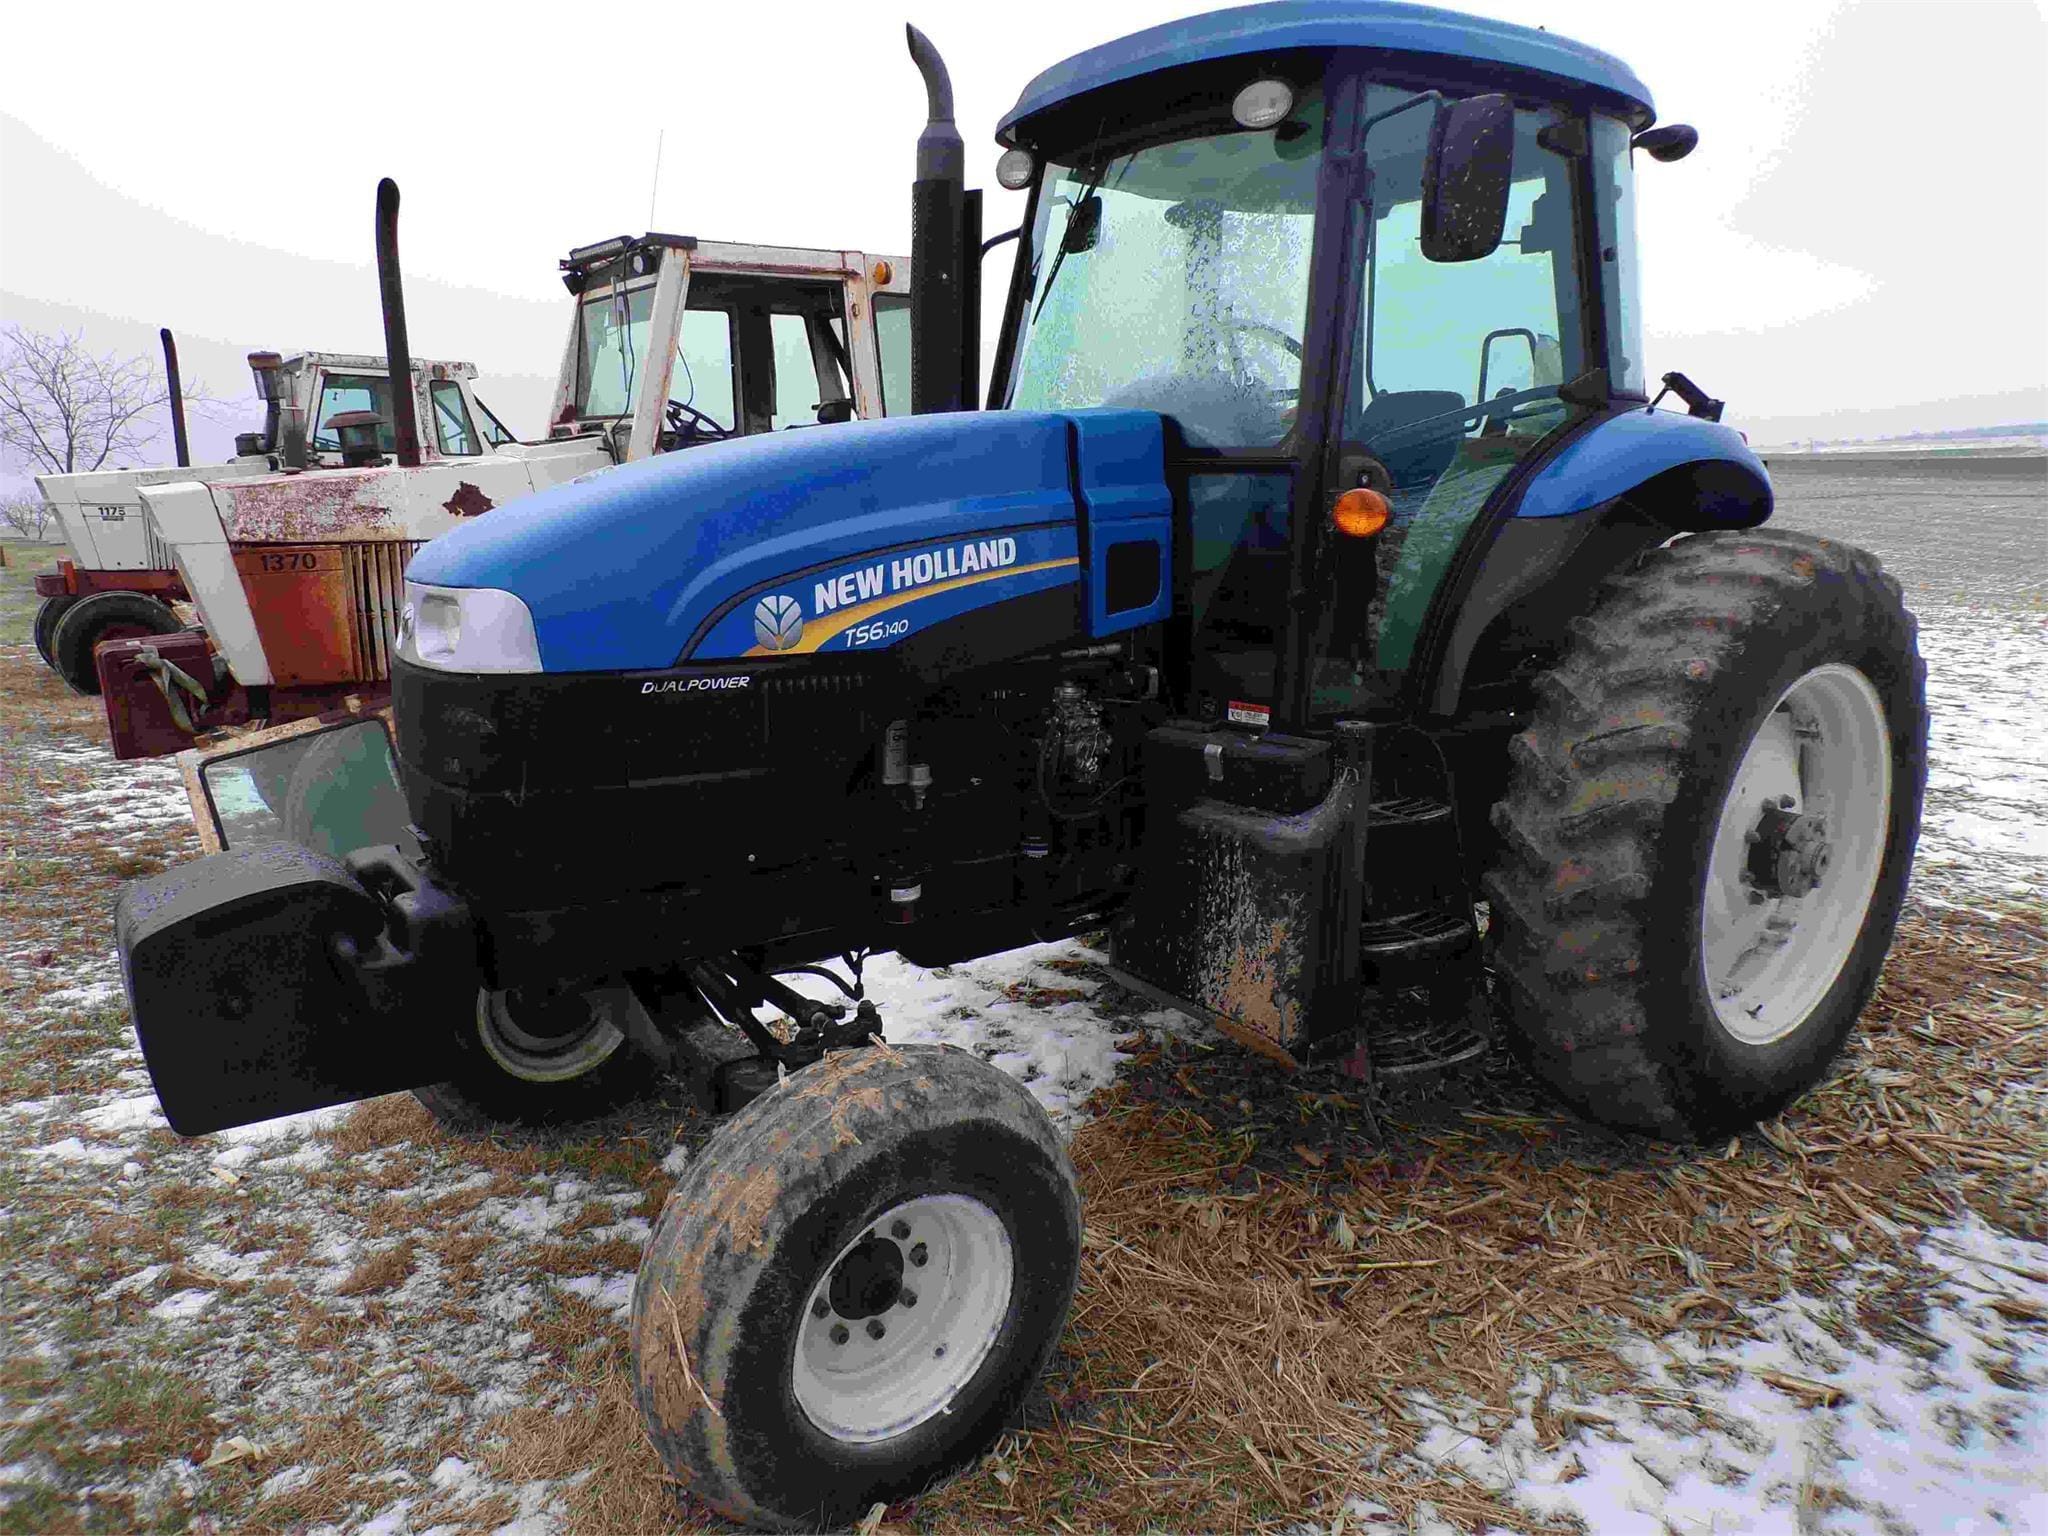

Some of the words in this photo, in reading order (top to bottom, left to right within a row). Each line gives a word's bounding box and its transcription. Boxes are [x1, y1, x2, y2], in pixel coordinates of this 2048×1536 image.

[260, 552, 317, 571] 1370
[814, 564, 885, 615] NEW
[891, 536, 1017, 590] HOLLAND
[845, 619, 909, 647] TS6.140
[641, 676, 750, 694] DUALPOWER
